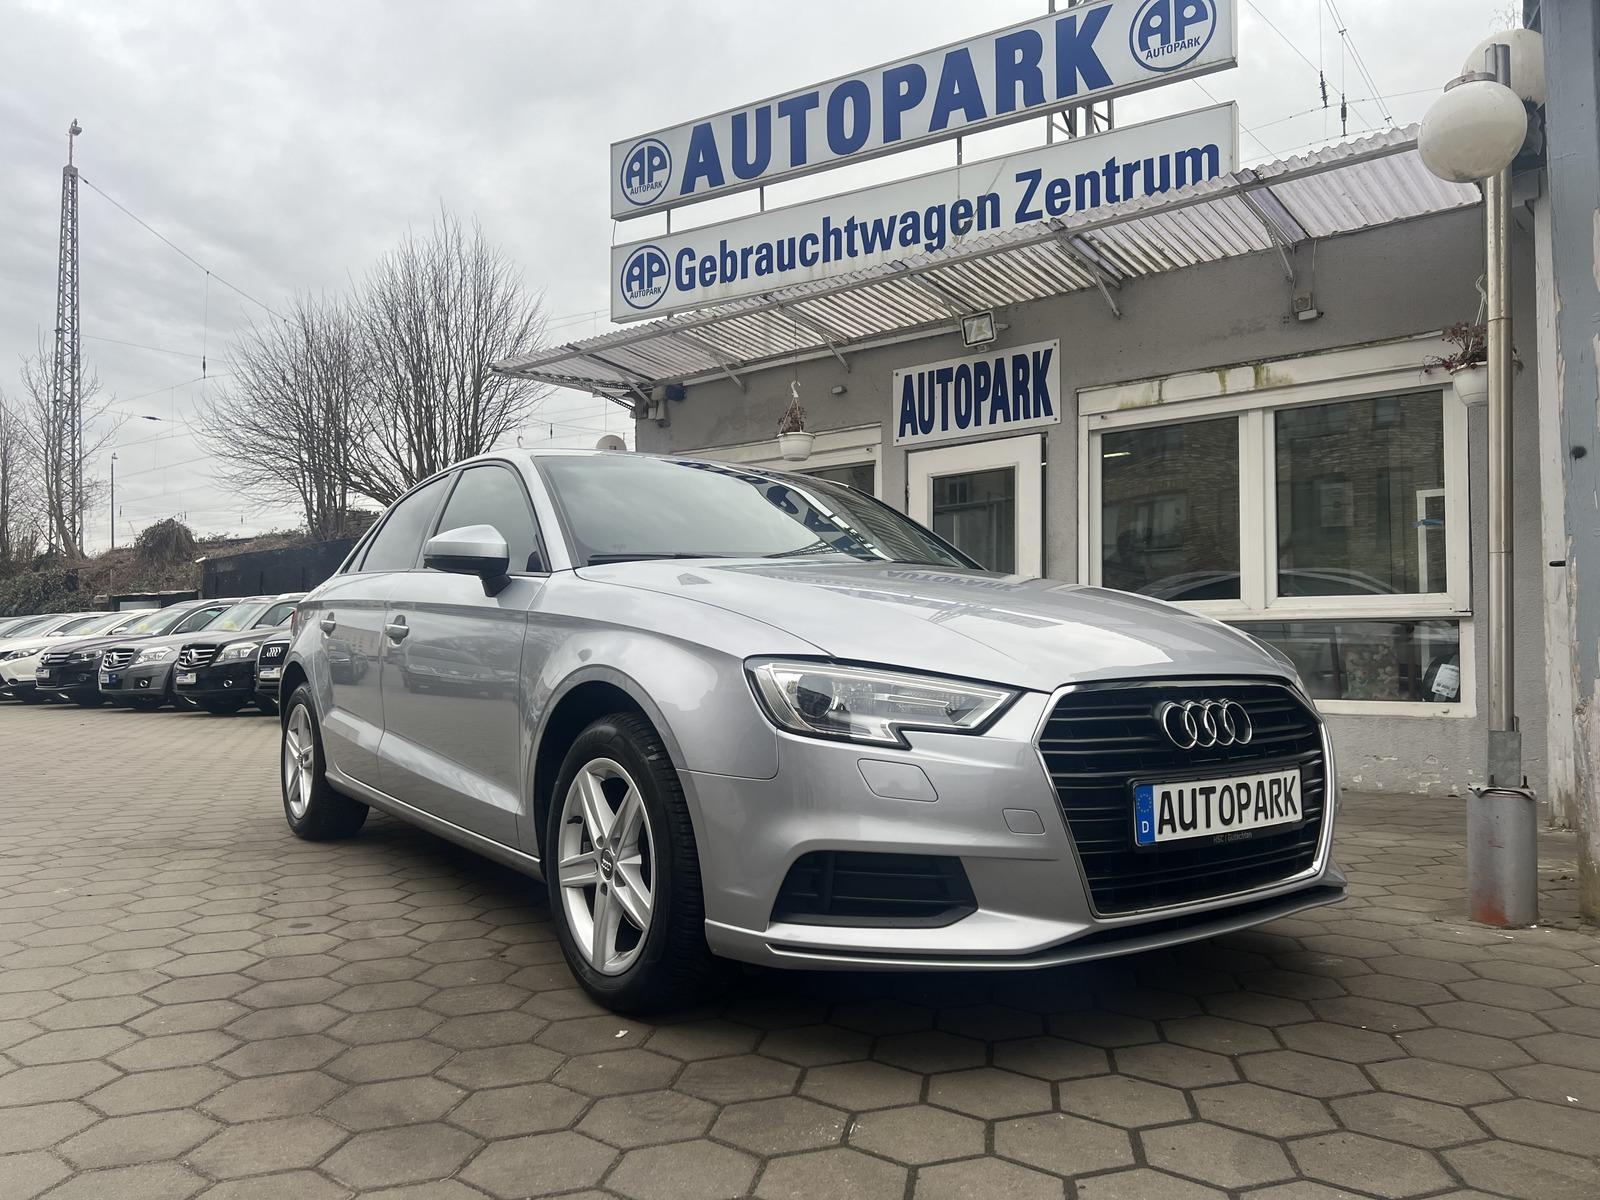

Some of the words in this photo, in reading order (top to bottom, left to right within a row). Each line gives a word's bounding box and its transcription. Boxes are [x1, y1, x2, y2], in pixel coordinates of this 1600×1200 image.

[1138, 0, 1208, 52] AP
[1145, 36, 1201, 60] AUTOPARK
[679, 4, 1114, 196] AUTOPARK
[625, 145, 668, 189] AP
[629, 180, 663, 195] AUTOPARK
[675, 192, 1000, 292] Gebrauchtwagen
[1015, 143, 1220, 224] Zentrum
[625, 252, 667, 293] AP
[629, 286, 662, 300] AUTOPARK
[898, 348, 1054, 437] AUTOPARK
[1142, 821, 1150, 834] D
[1157, 775, 1298, 835] AUTOPARK
